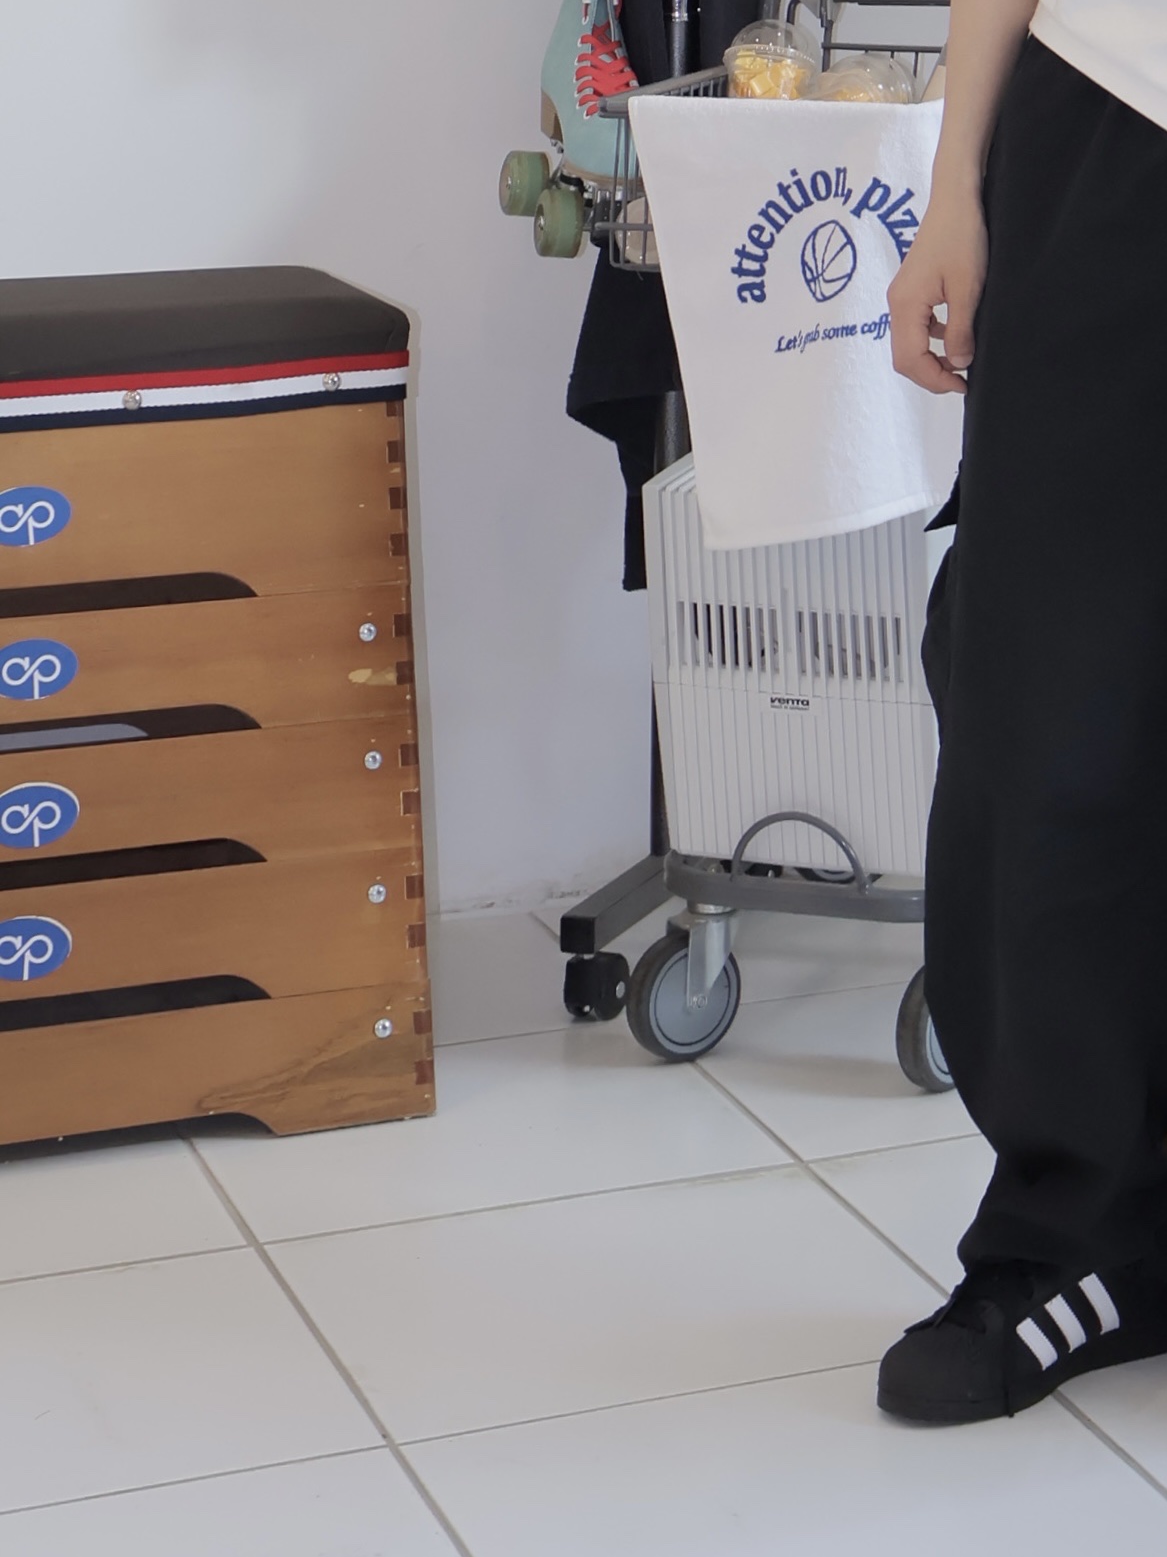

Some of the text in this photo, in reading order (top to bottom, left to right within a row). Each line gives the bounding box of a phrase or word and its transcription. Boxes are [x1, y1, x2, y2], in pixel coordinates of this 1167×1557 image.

[731, 166, 853, 304] attention,
[821, 324, 858, 341] some
[860, 313, 891, 341] coff
